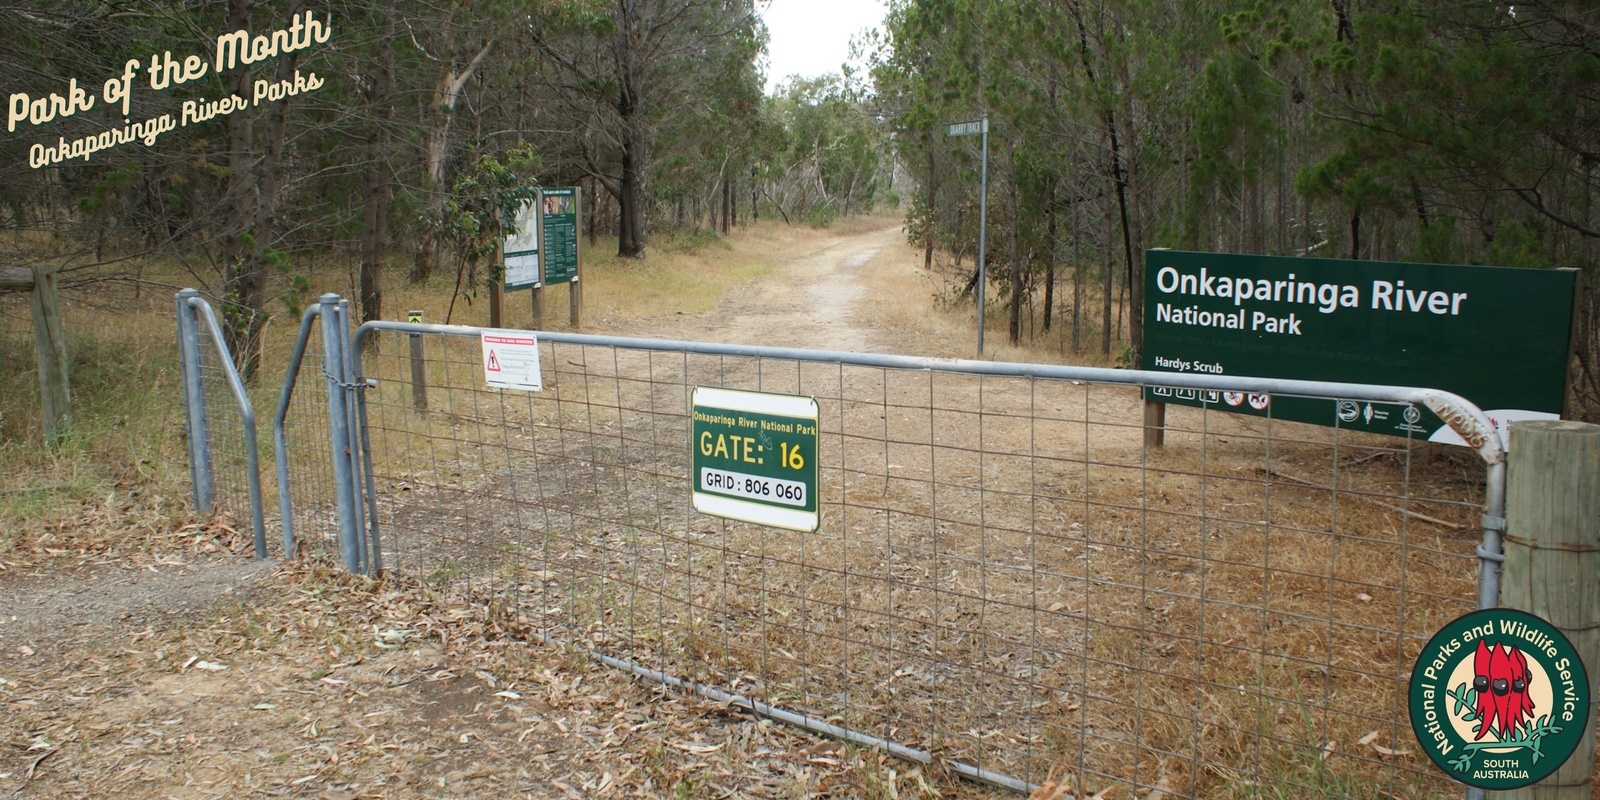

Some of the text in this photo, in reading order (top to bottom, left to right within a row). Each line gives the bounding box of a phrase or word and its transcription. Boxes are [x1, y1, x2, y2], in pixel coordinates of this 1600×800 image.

[950, 121, 980, 135] QUARRY TRACK
[1156, 266, 1468, 316] Onkaparinga River
[1156, 302, 1303, 336] National Park
[1155, 356, 1224, 374] Hardys Scrub
[693, 411, 816, 436] Onkaparinga River National Park
[700, 431, 764, 464] GATE:
[780, 442, 804, 470] 16
[745, 479, 770, 496] 806
[775, 483, 803, 501] 060
